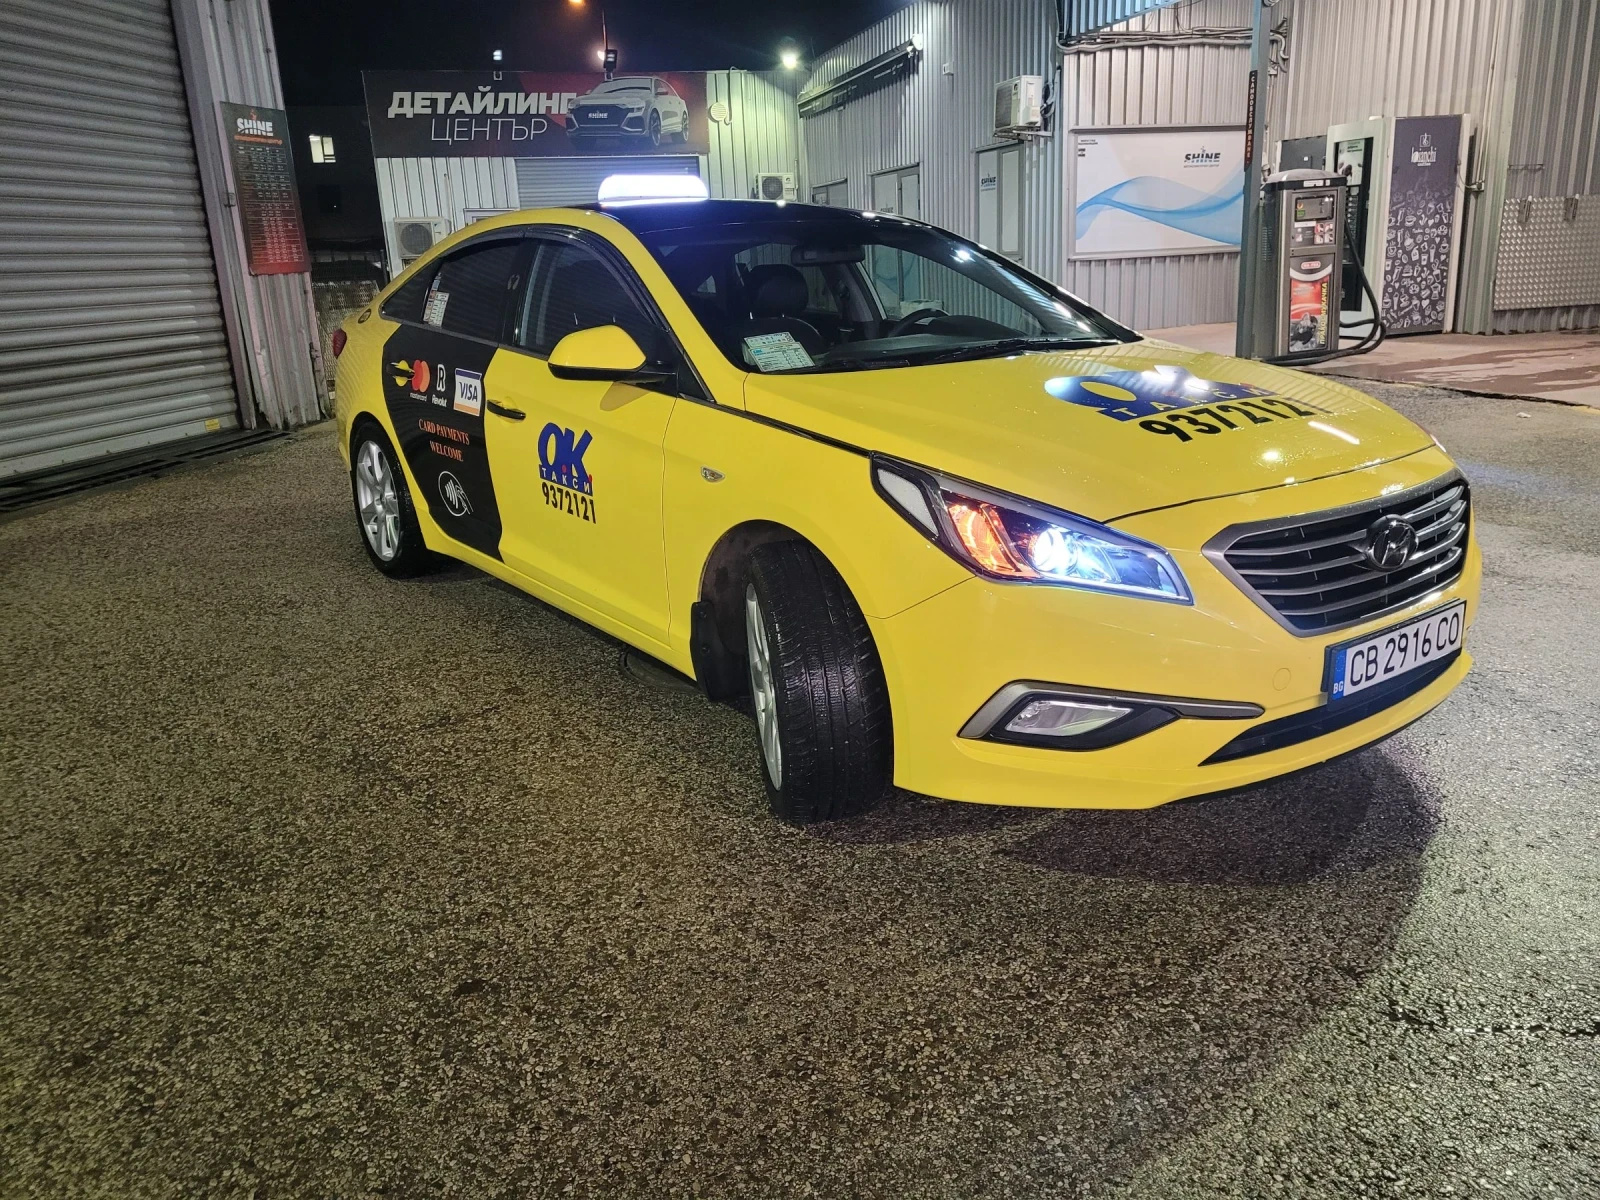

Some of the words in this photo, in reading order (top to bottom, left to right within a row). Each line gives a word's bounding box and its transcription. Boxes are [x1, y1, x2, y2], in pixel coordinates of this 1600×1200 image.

[387, 85, 577, 119] ДЕТАЙЛИНГ
[236, 118, 274, 137] SHINE
[431, 118, 548, 145] ЦЕНТЪР
[1183, 153, 1221, 163] SHINE
[459, 382, 478, 402] VISA
[418, 419, 436, 434] CARD
[436, 424, 470, 446] PAYMENTS
[429, 440, 464, 462] WELCOME
[542, 467, 591, 494] ТАКСИ
[541, 481, 597, 525] 9372121
[1350, 645, 1378, 687] CB
[1383, 623, 1432, 675] 2916
[1436, 612, 1460, 651] CO
[1333, 680, 1344, 695] BG
